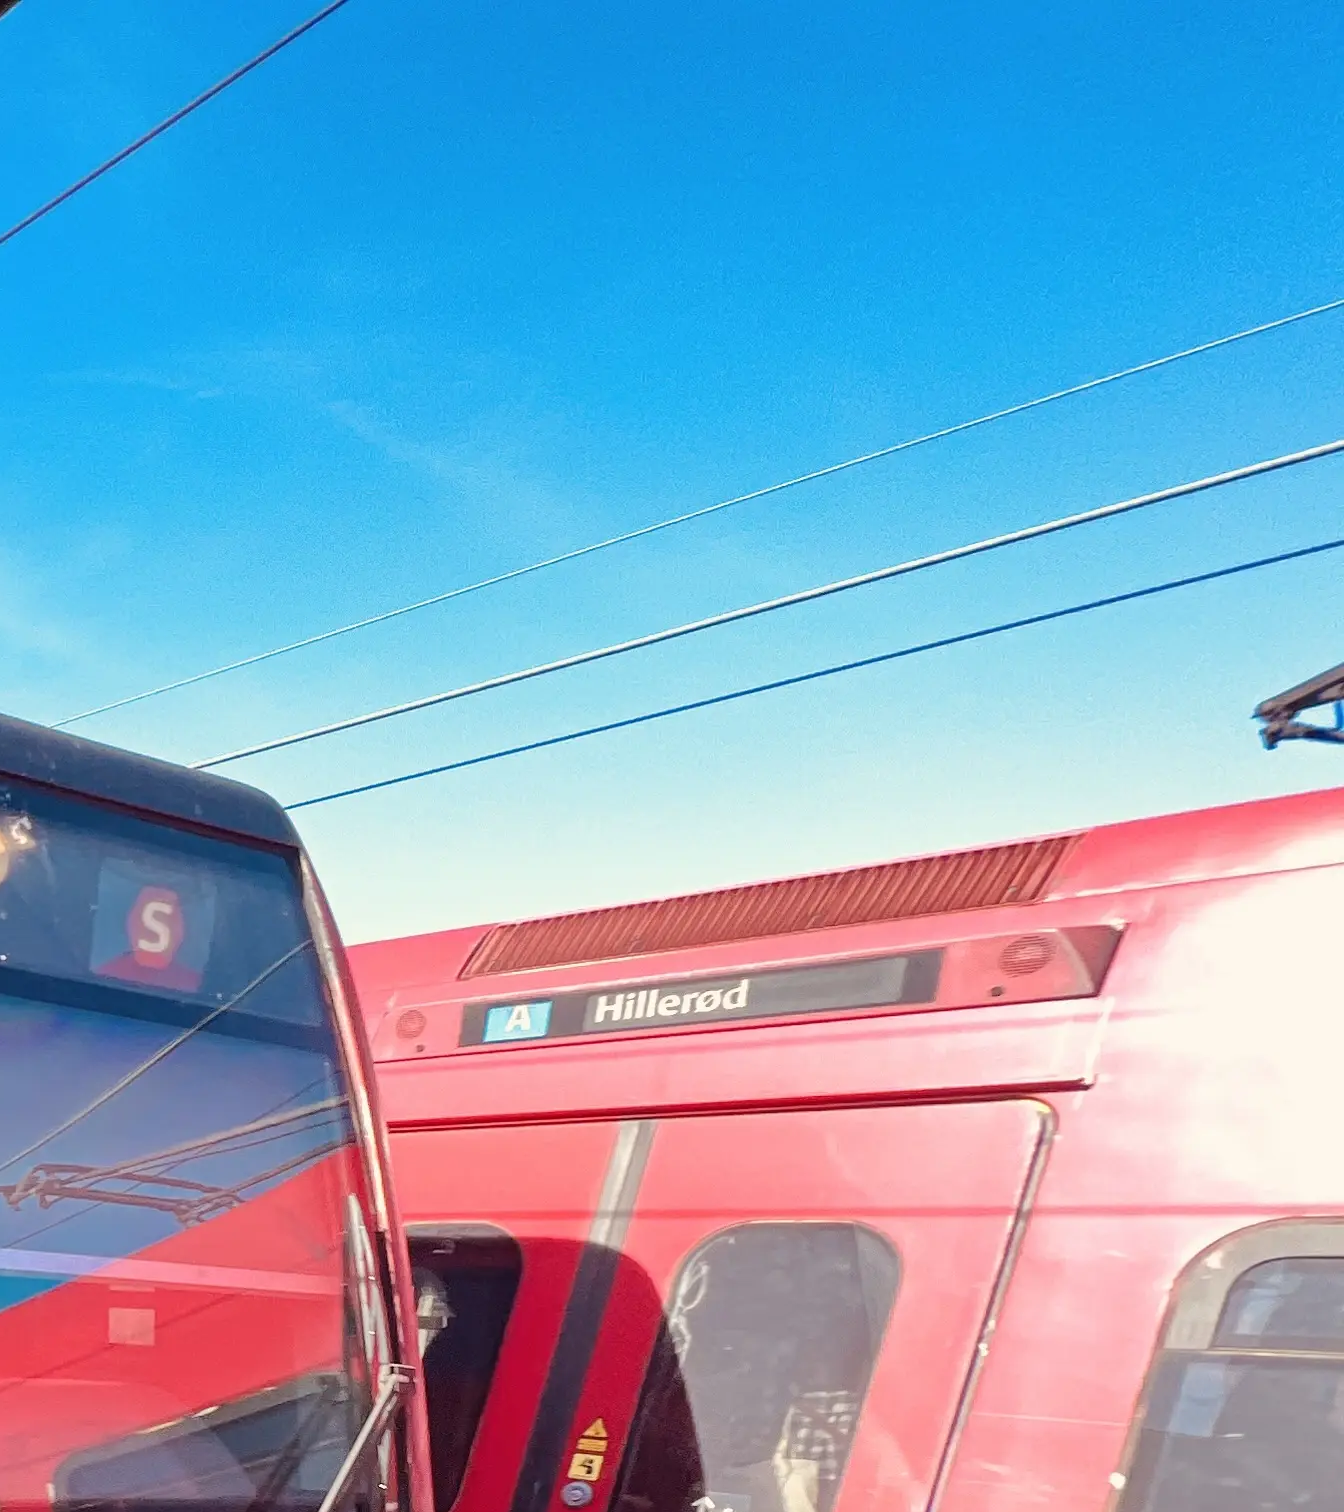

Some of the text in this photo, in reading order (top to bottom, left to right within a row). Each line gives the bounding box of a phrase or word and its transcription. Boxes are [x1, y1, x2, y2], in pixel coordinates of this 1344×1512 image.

[137, 901, 174, 953] S
[504, 978, 751, 1033] A Hillerød
